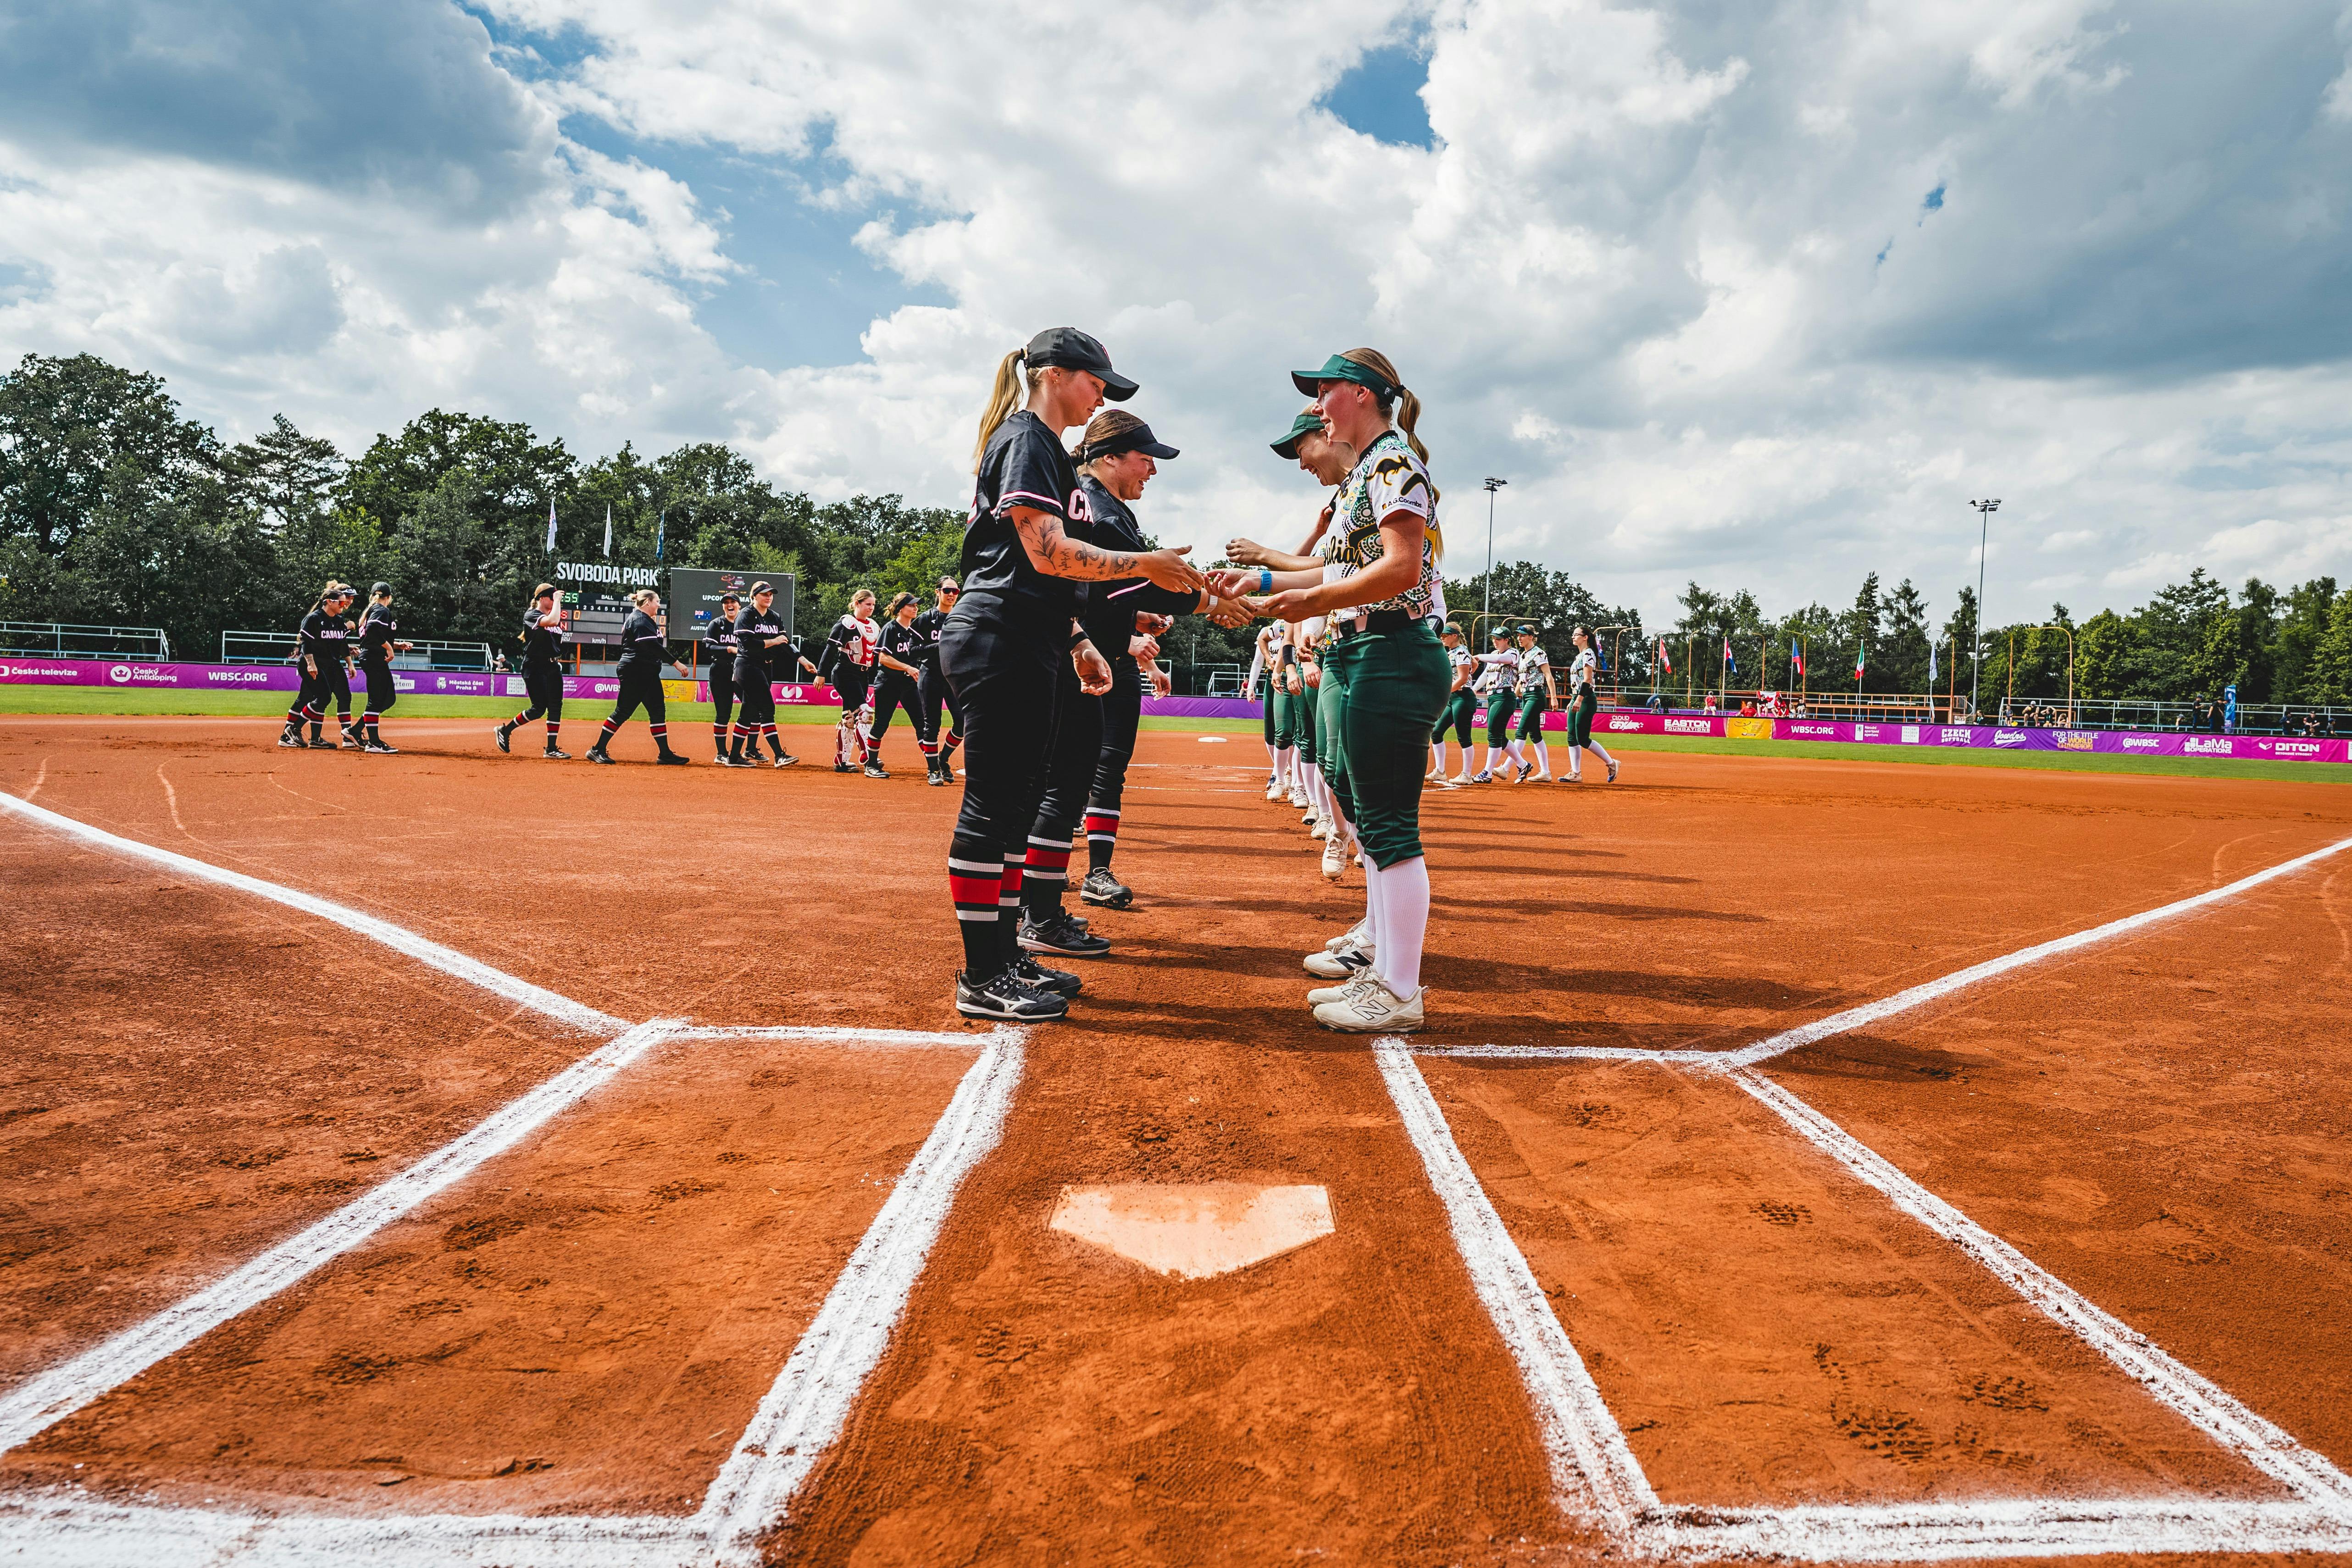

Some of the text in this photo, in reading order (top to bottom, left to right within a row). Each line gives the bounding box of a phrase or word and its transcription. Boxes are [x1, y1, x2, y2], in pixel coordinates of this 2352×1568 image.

[557, 562, 659, 586] SVOBODA PARK
[573, 610, 580, 620] 0
[660, 615, 666, 625] 0
[133, 666, 159, 676] Český
[208, 672, 267, 681] WBSC.ORG
[1664, 719, 1711, 727] EASTON
[1791, 726, 1834, 734] WBSC.ORG
[1942, 729, 1971, 739] CZECH
[2123, 738, 2159, 748] @WBSC
[2196, 738, 2232, 749] LaMa
[2275, 742, 2319, 752] DITON
